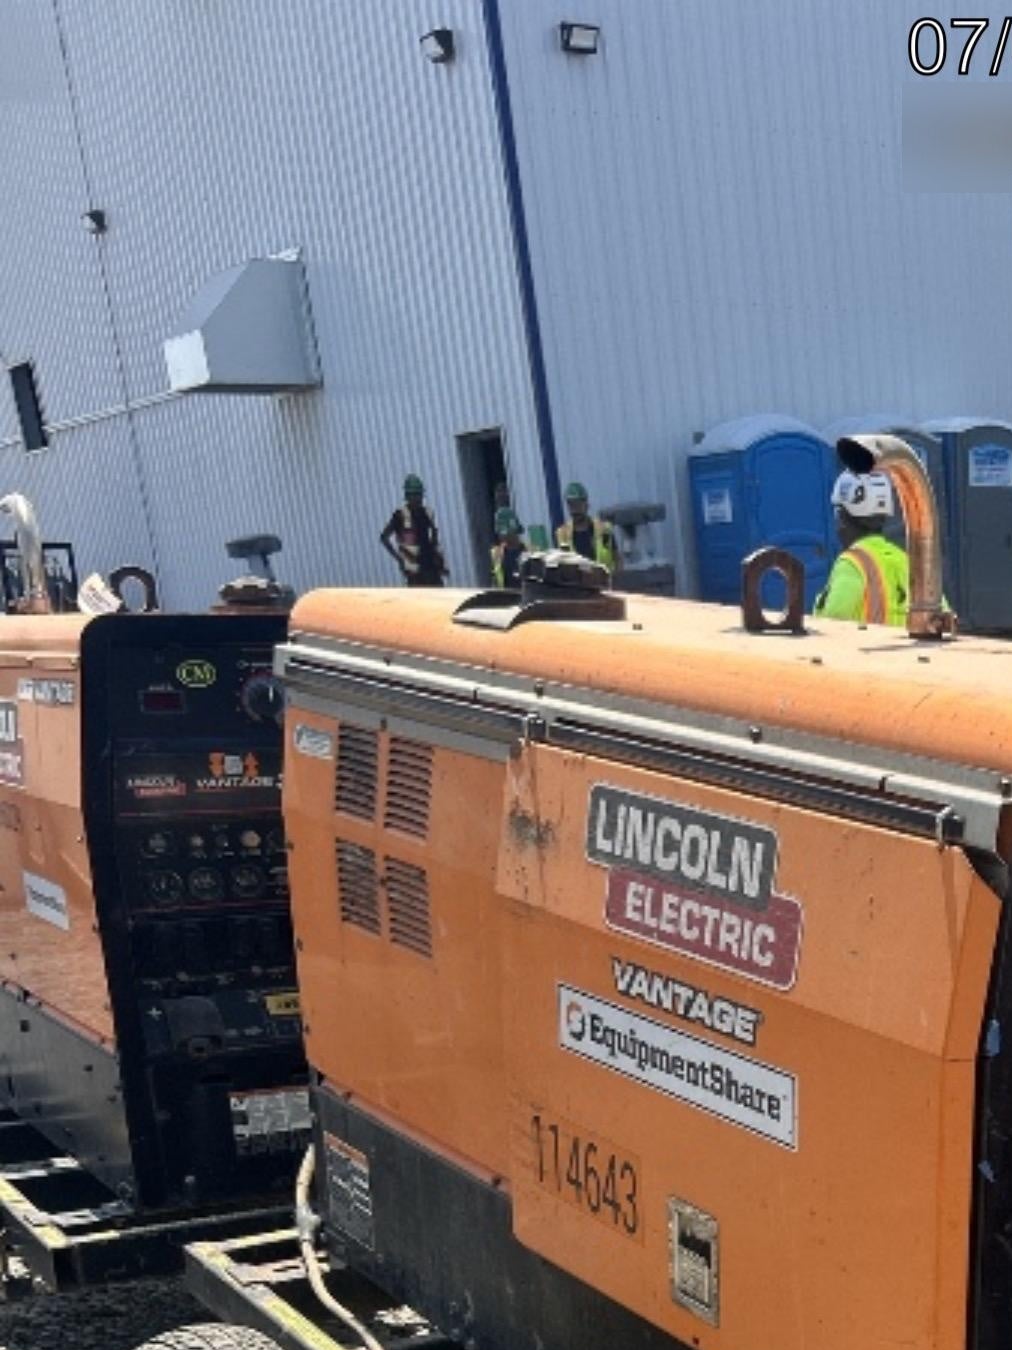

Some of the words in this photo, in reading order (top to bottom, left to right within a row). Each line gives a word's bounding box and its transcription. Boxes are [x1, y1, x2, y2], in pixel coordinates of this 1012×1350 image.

[595, 799, 765, 899] LINCOLN
[624, 880, 776, 968] ELECTRIC
[612, 957, 761, 1046] VANTAGE
[589, 1013, 782, 1123] EquipmentShare
[531, 1114, 638, 1234] 114643
